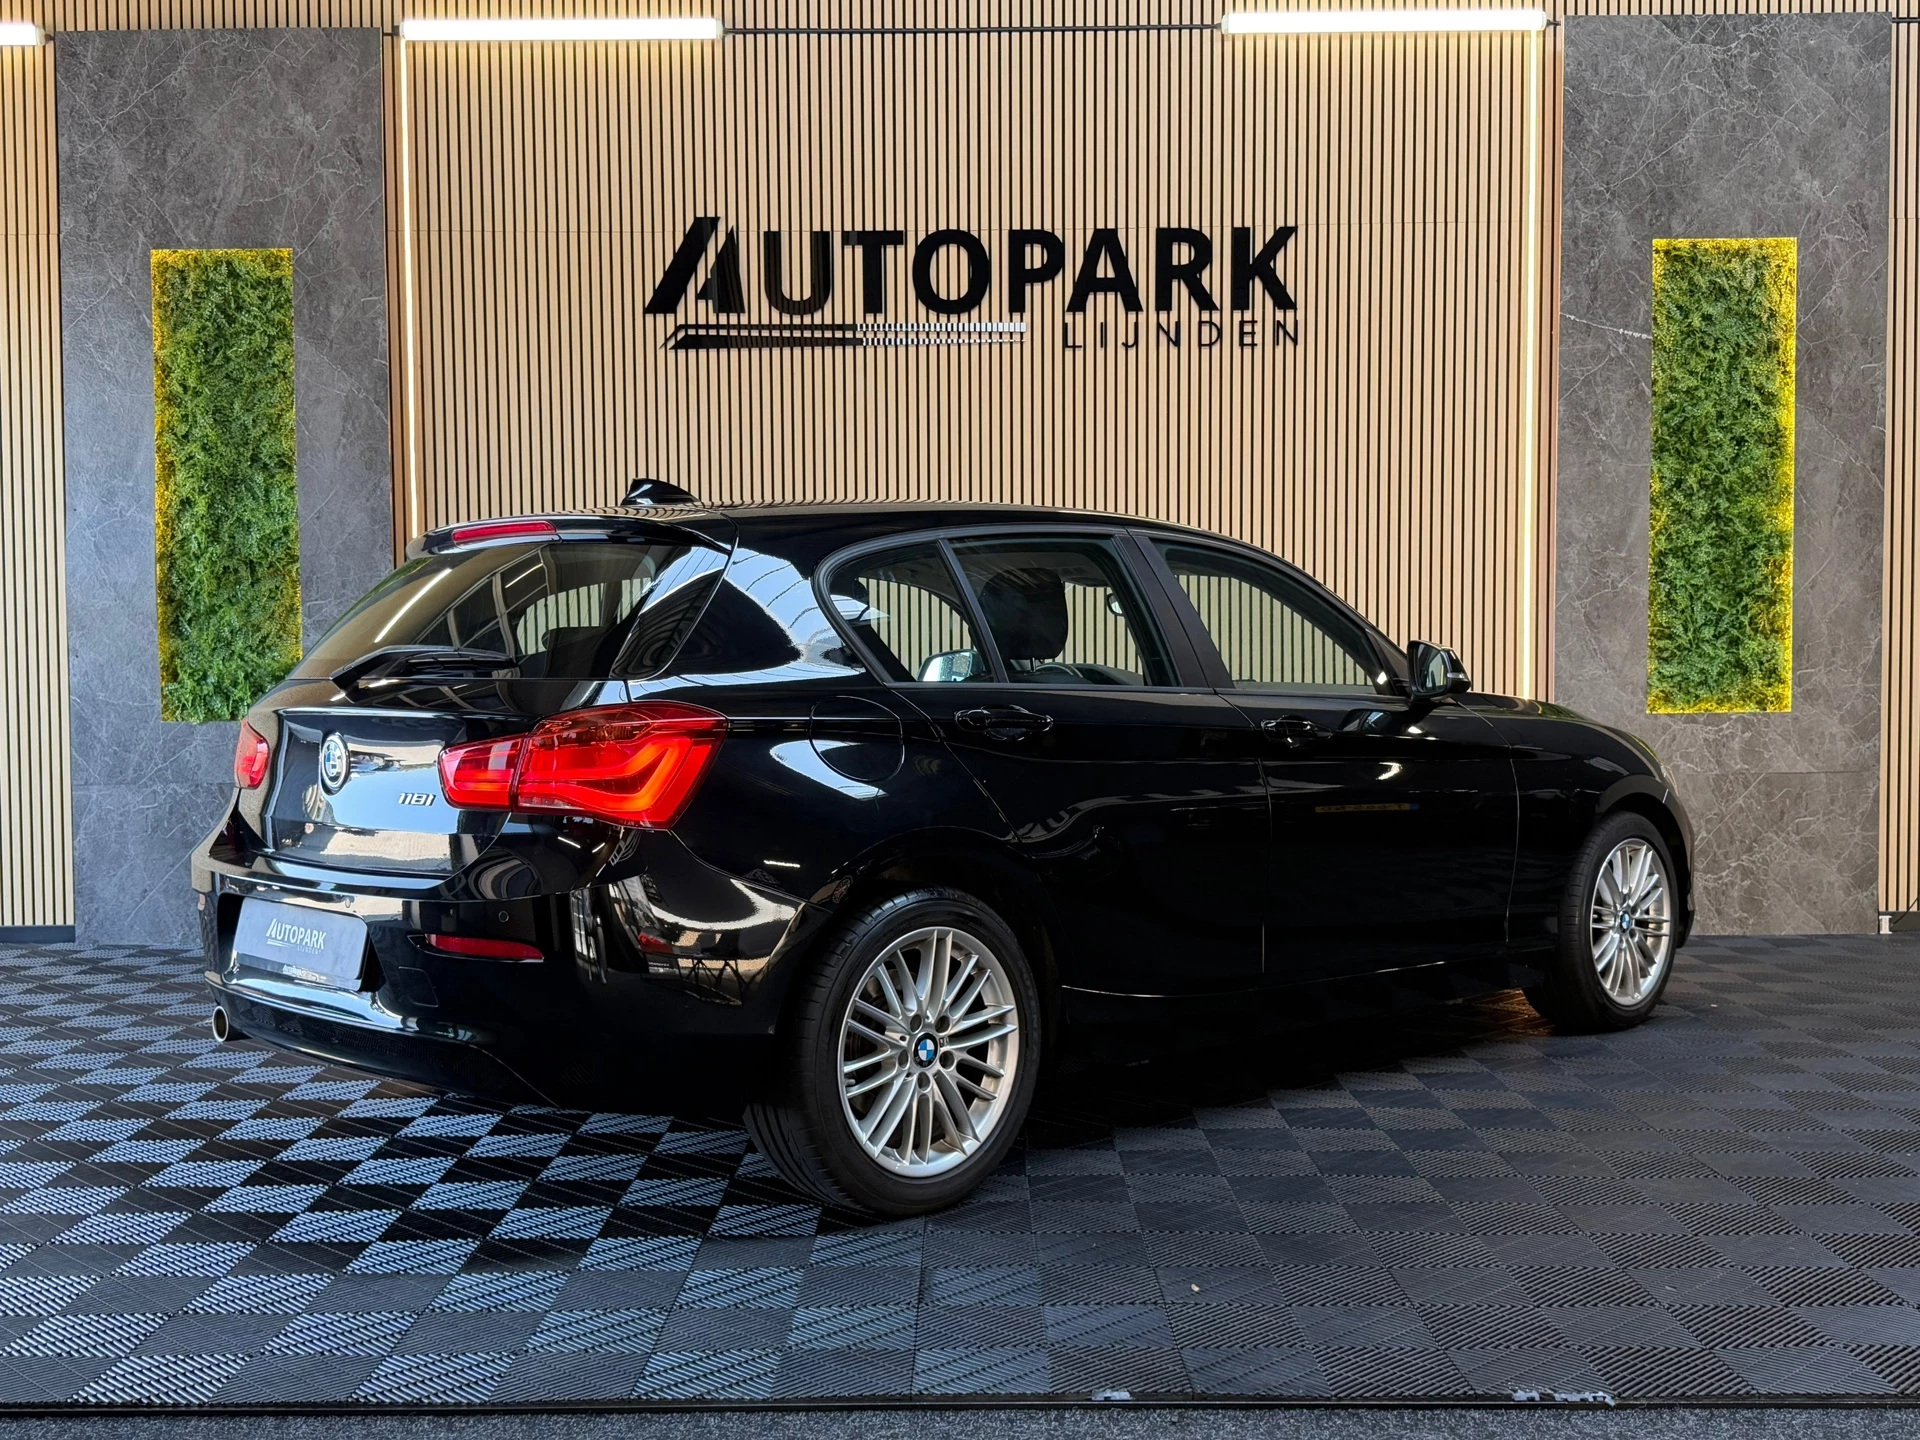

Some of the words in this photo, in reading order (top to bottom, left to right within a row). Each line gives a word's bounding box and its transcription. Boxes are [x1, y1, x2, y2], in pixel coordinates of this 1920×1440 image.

[644, 216, 1299, 316] AUTOPARK
[1064, 318, 1299, 349] LIJNDEN
[266, 918, 327, 950] AUTOPARK
